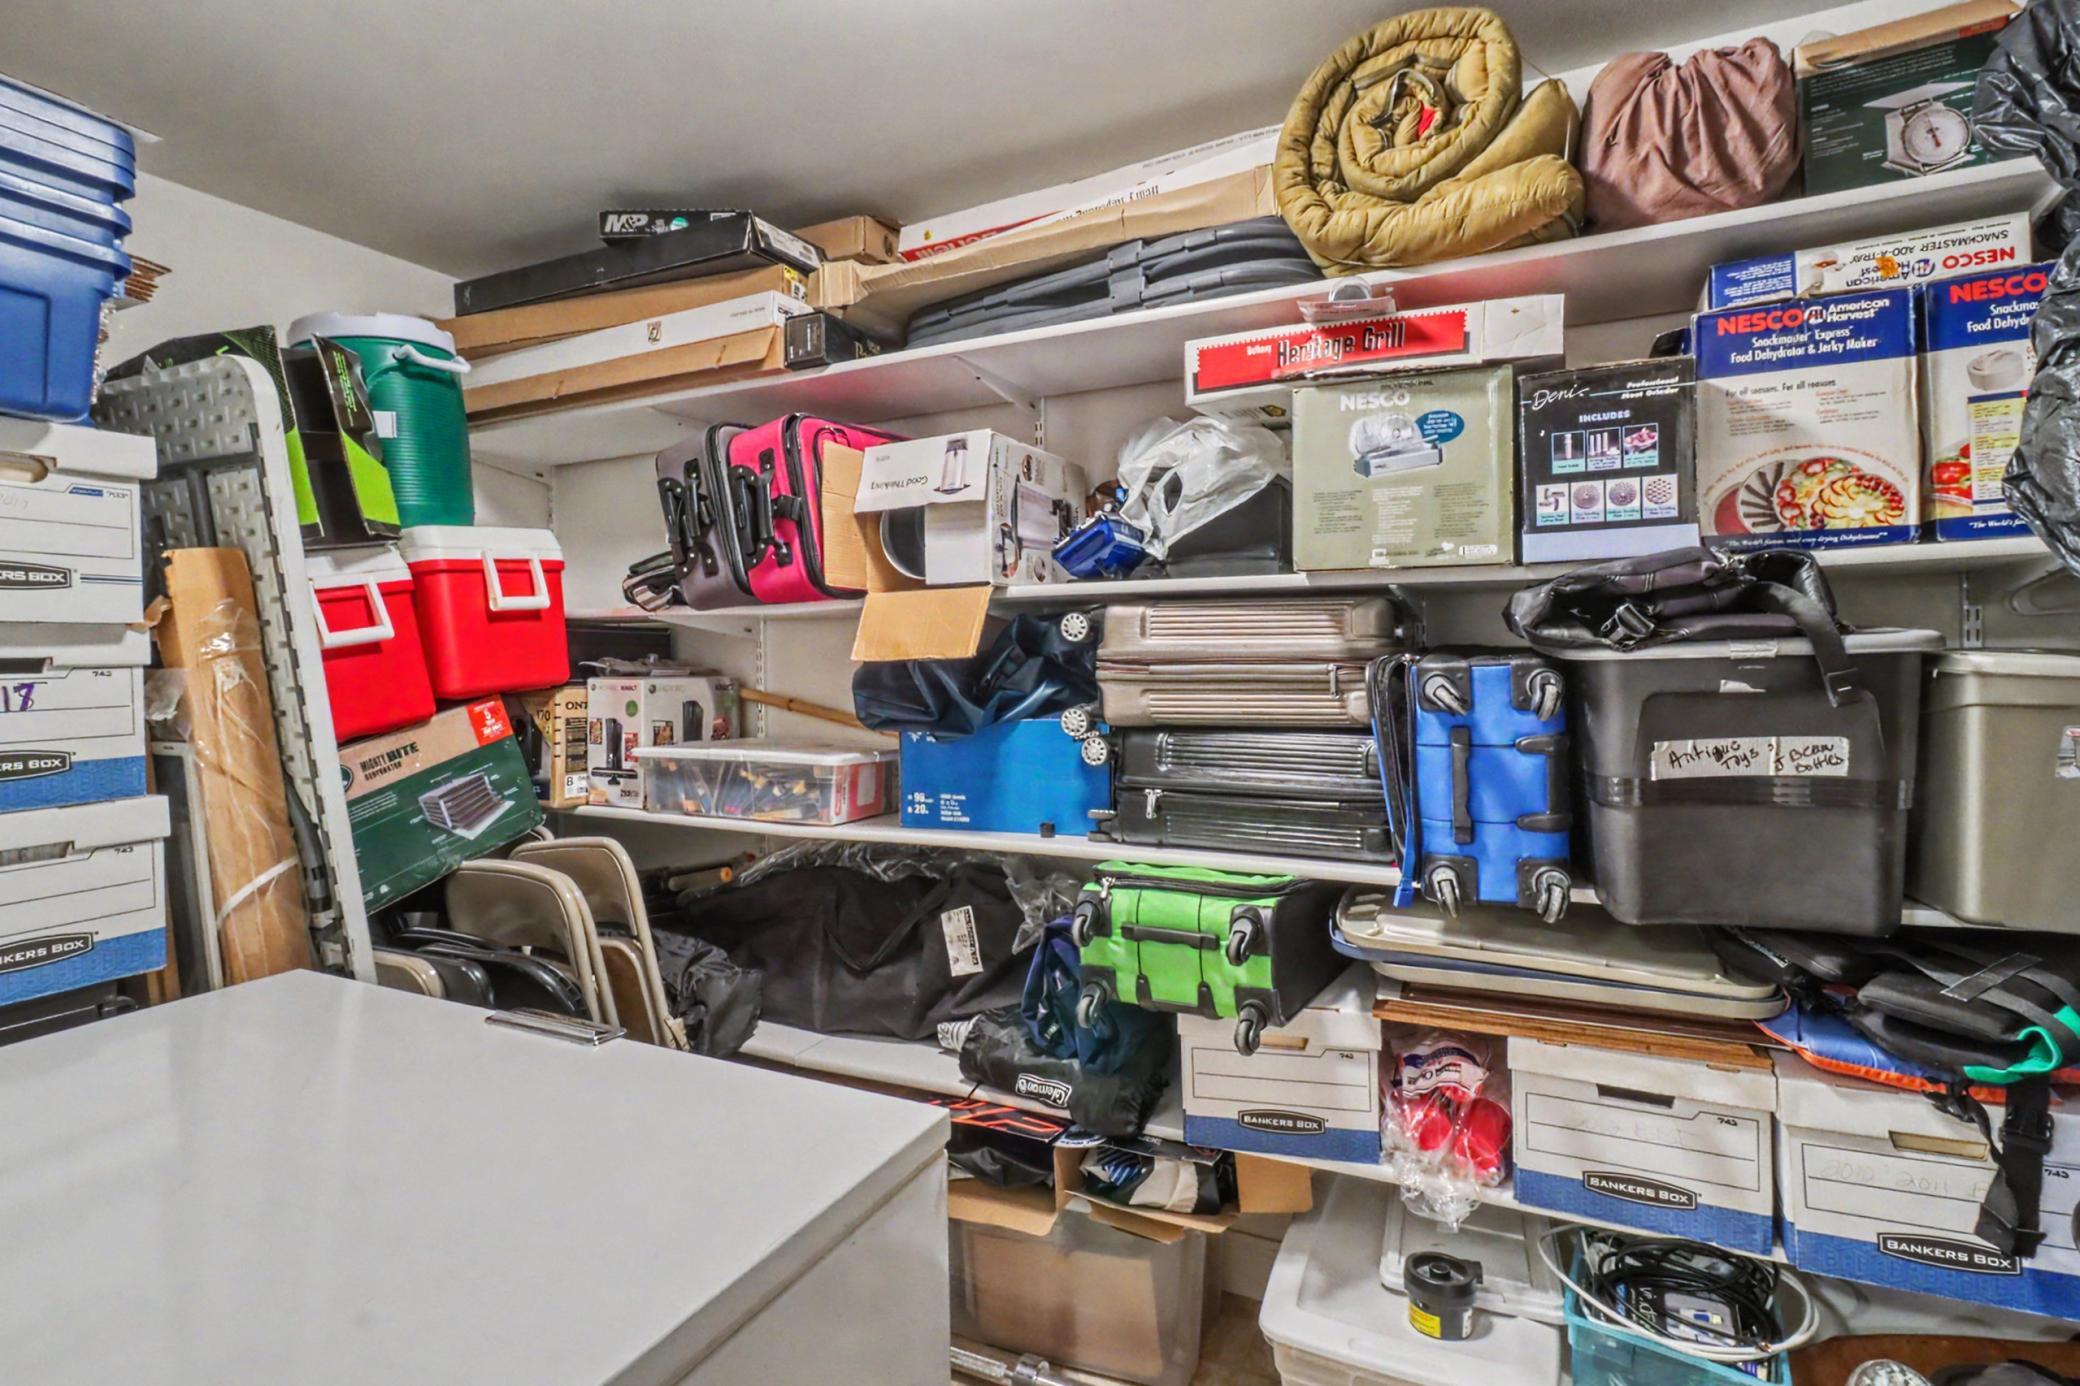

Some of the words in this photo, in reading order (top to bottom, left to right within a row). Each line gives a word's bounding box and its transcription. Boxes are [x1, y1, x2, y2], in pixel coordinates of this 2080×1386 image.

[1942, 246, 2015, 270] NESCO
[1950, 272, 2049, 304] NESCO
[1827, 308, 1878, 323] Harvest
[1828, 298, 1890, 313] American
[1717, 308, 1803, 336] NESCO
[1966, 318, 1991, 333] Food
[1276, 333, 1356, 367] Heritage
[1363, 321, 1406, 350] Grill
[1730, 351, 1752, 364] Food
[1754, 345, 1805, 361] Dehydrator
[1807, 345, 1818, 355] &
[1817, 341, 1845, 354] Jerky
[1846, 338, 1878, 350] Maker
[1339, 389, 1411, 412] NESCO
[1579, 409, 1630, 422] INCLUDES
[28, 572, 66, 582] BOX
[0, 761, 23, 772] RS
[28, 758, 62, 769] BOX
[51, 939, 85, 954] BOX
[1027, 1081, 1066, 1105] Coleman
[1243, 1114, 1293, 1128] BANKERS
[1296, 1121, 1320, 1129] BOX
[1589, 1176, 1656, 1198] BANKERS
[1658, 1190, 1690, 1204] BOX
[1886, 1239, 1969, 1262] BANKERS
[1973, 1253, 2013, 1269] BOX
